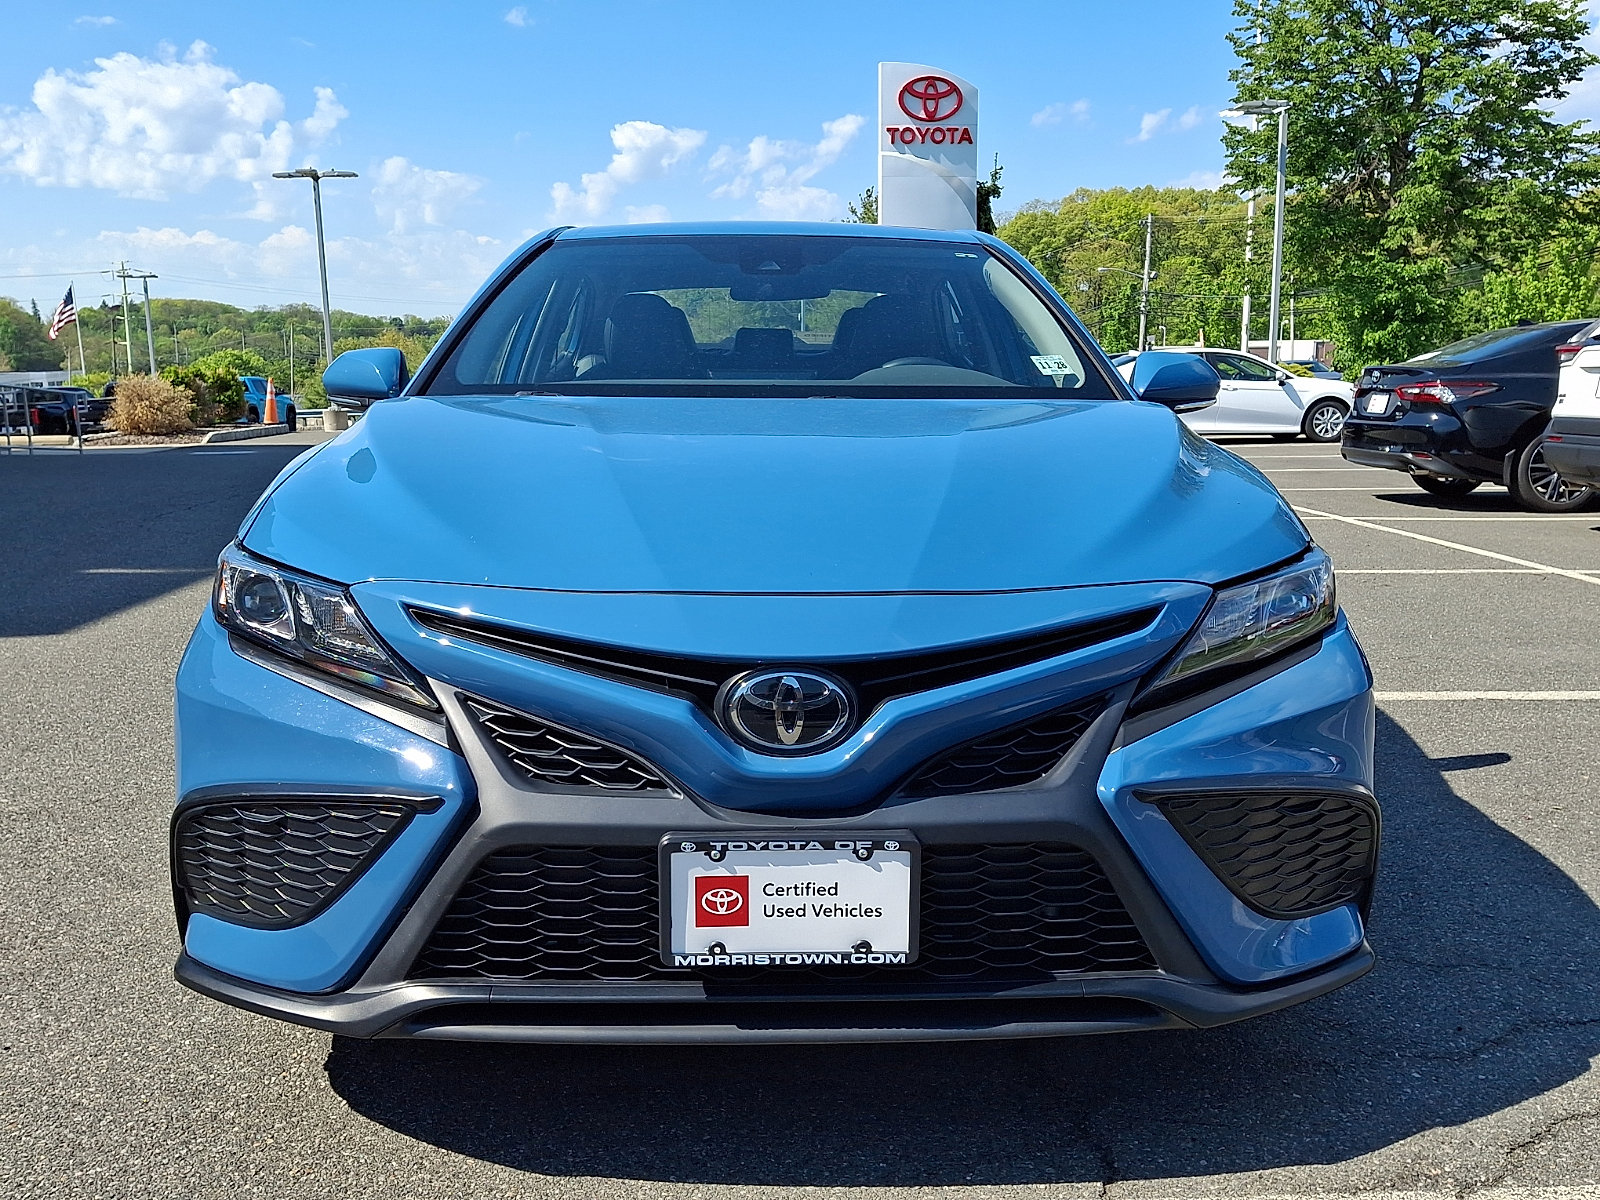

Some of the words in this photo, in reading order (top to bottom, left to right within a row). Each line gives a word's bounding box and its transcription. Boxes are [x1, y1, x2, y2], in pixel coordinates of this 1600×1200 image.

[886, 127, 973, 144] TOYOTA
[710, 841, 825, 851] TOYOTA
[834, 841, 873, 850] OF
[762, 882, 839, 897] Certified
[763, 903, 807, 918] Used
[812, 903, 883, 918] Vehicles
[674, 953, 906, 966] MORRISTOWN.COM
